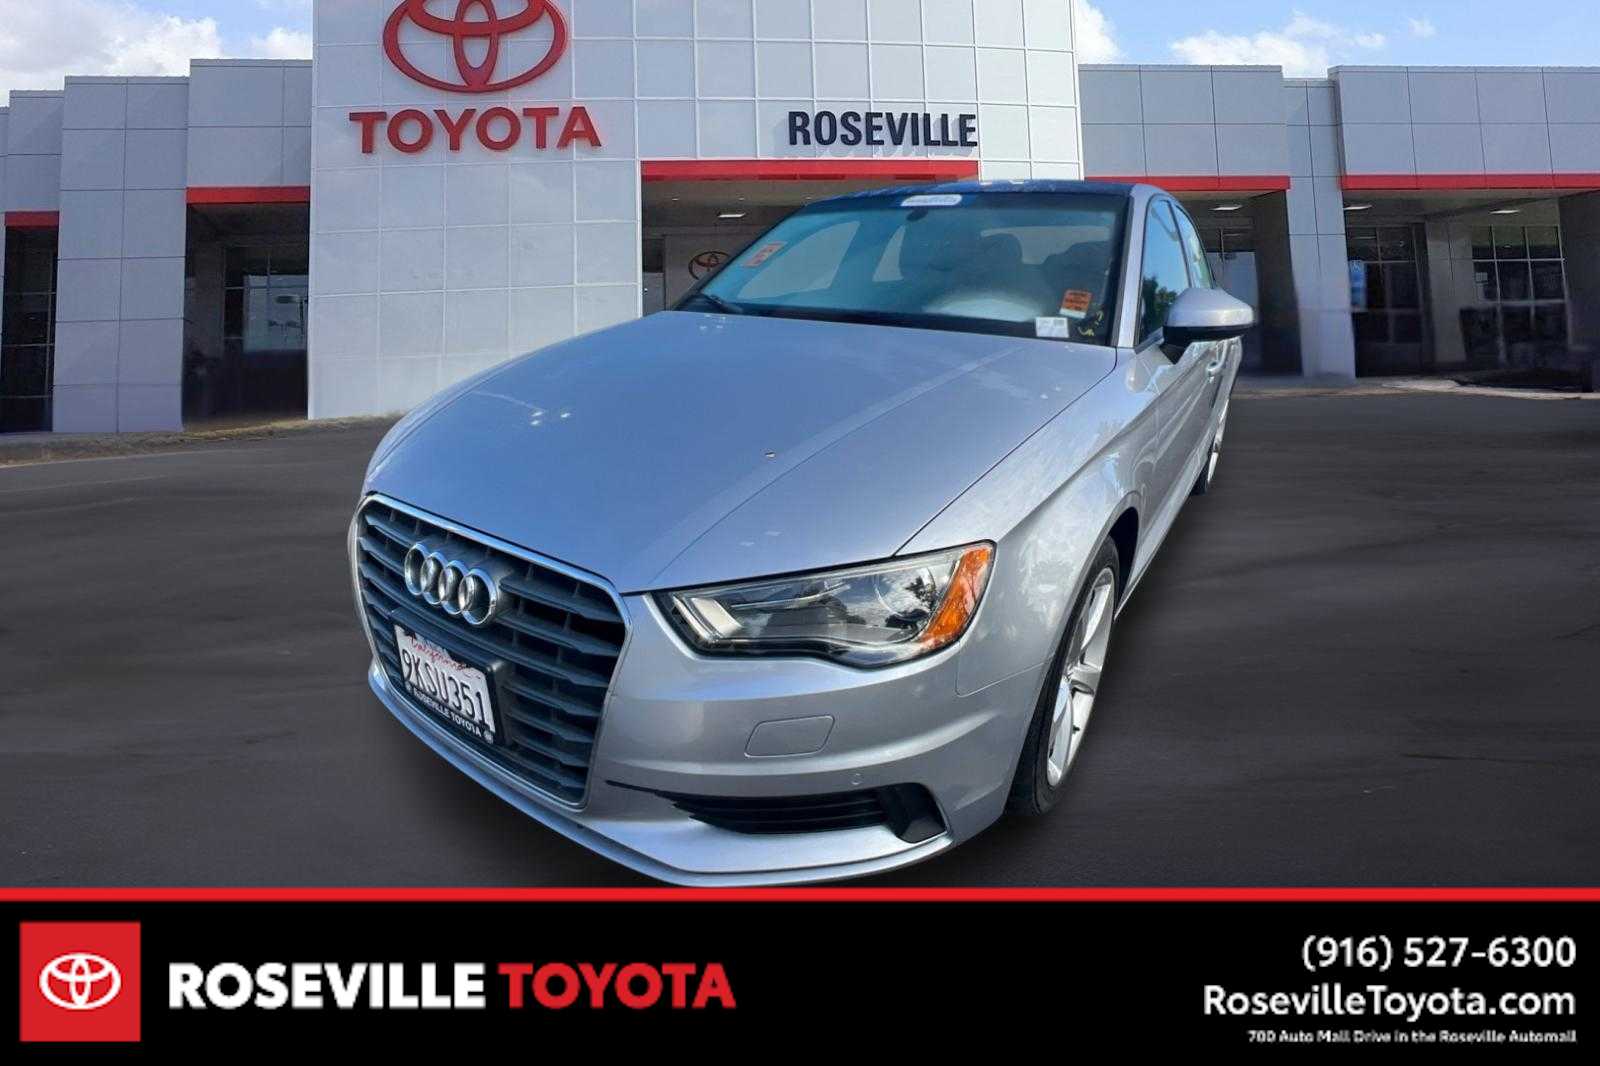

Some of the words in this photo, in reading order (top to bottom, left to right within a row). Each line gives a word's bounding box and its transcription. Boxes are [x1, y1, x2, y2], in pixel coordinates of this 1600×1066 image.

[350, 107, 602, 154] TOYOTA
[788, 111, 978, 147] ROSEVILLE
[451, 712, 481, 738] TOYOTA
